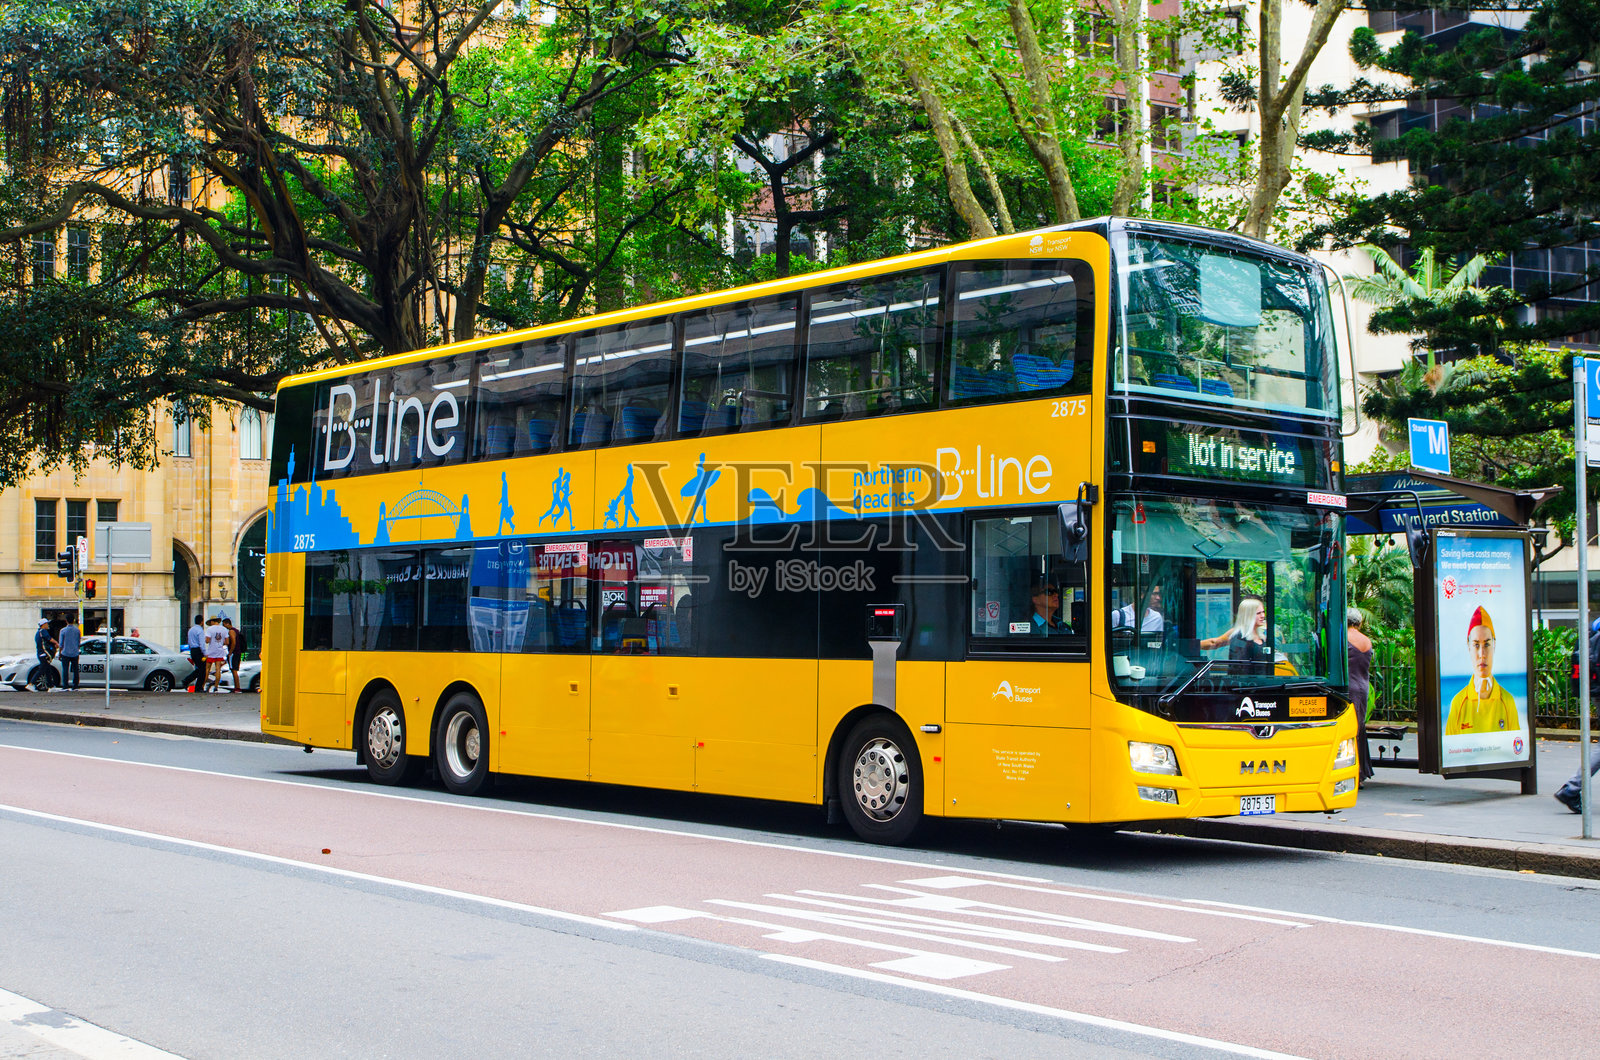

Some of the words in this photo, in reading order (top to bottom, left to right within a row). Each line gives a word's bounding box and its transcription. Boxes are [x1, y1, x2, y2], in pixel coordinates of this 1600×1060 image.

[1047, 236, 1071, 246] Transport
[1030, 246, 1043, 254] NSW
[1055, 244, 1069, 252] NSW
[1051, 400, 1086, 418] 2875
[1412, 423, 1427, 433] Stand
[1428, 425, 1446, 455] M
[1188, 432, 1217, 467] Not
[1220, 436, 1234, 469] in
[1238, 442, 1296, 475] service
[853, 464, 921, 488] northern
[853, 488, 916, 511] beaches
[1308, 493, 1344, 508] EMERGENCY
[1451, 508, 1499, 523] Station
[294, 533, 316, 550] 2875
[644, 538, 676, 548] EMERGENCY
[680, 537, 692, 546] EXIT
[545, 543, 575, 552] EMERGENCY
[1441, 548, 1460, 559] Saving
[1462, 549, 1474, 557] lives
[1475, 550, 1490, 558] costs
[1491, 551, 1512, 560] money.
[1441, 561, 1451, 569] We
[1452, 561, 1467, 569] need
[1468, 562, 1480, 571] your
[1481, 561, 1512, 569] donations.
[1014, 685, 1041, 695] Transport
[1015, 695, 1032, 703] Buses
[1254, 701, 1277, 709] Transport
[1309, 707, 1325, 715] DRIVER
[1240, 760, 1286, 774] MAN
[1241, 797, 1261, 811] 2875
[1264, 796, 1275, 810] ST
